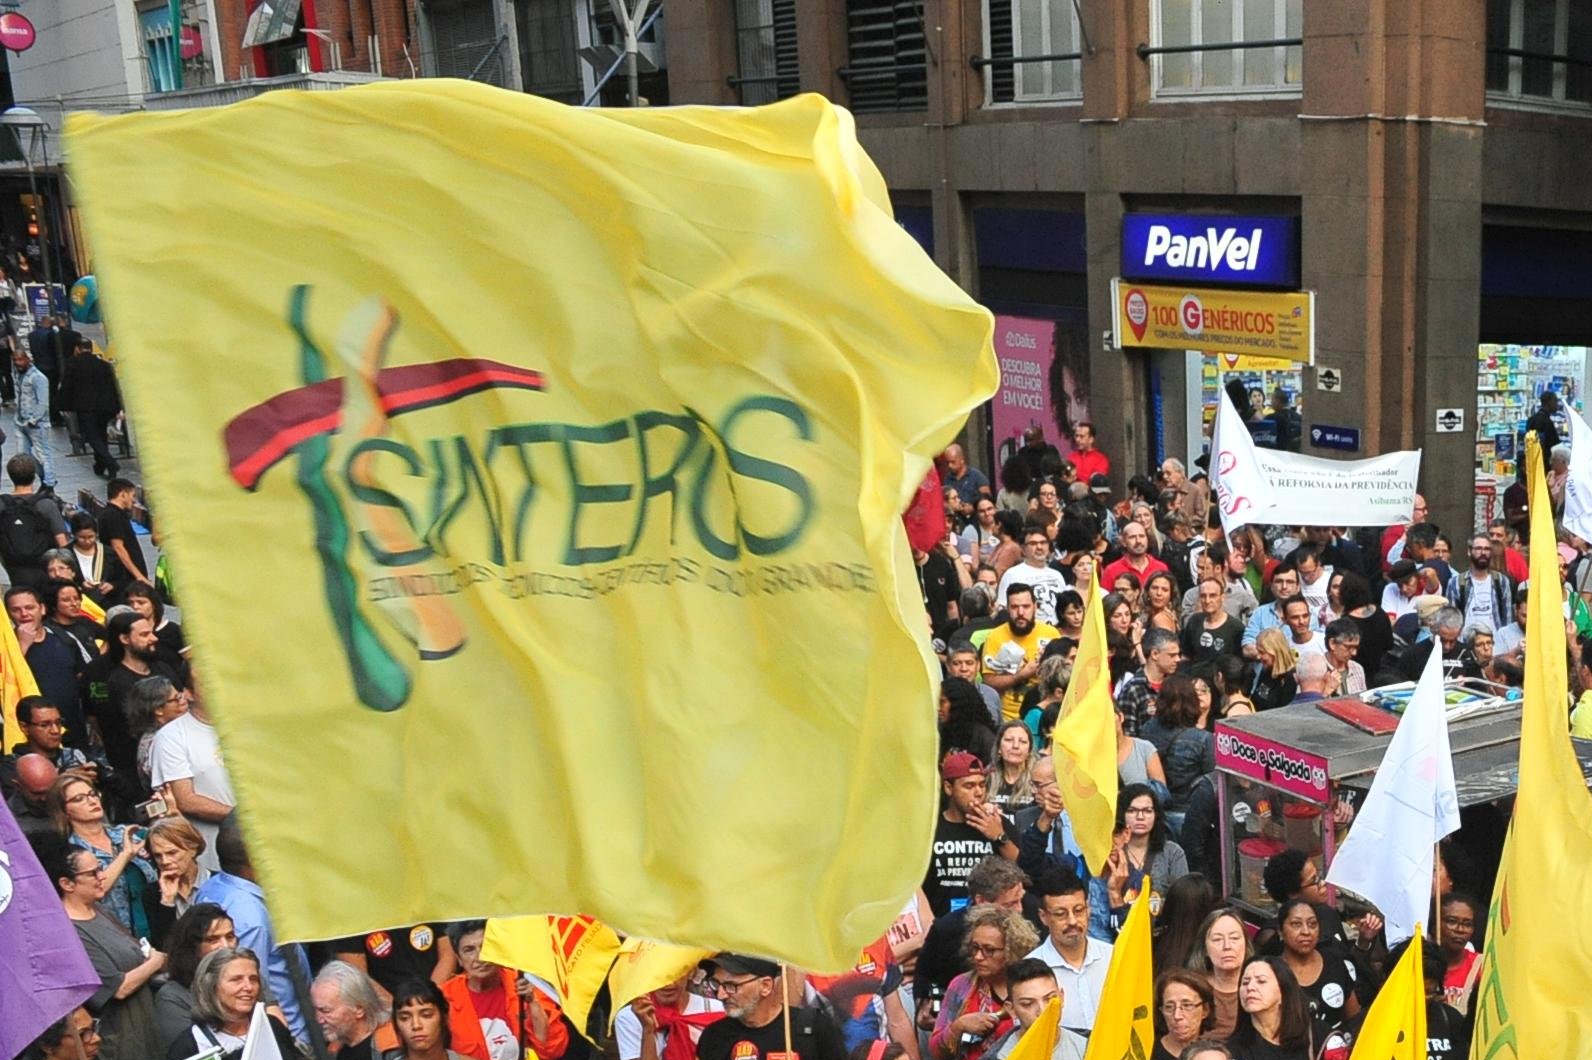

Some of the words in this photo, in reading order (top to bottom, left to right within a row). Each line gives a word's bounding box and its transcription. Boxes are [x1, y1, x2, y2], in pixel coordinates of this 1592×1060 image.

[1145, 225, 1263, 272] PanVel
[1152, 306, 1178, 327] 100
[1002, 358, 1042, 377] DESCUBRA
[933, 840, 994, 855] CONTRA
